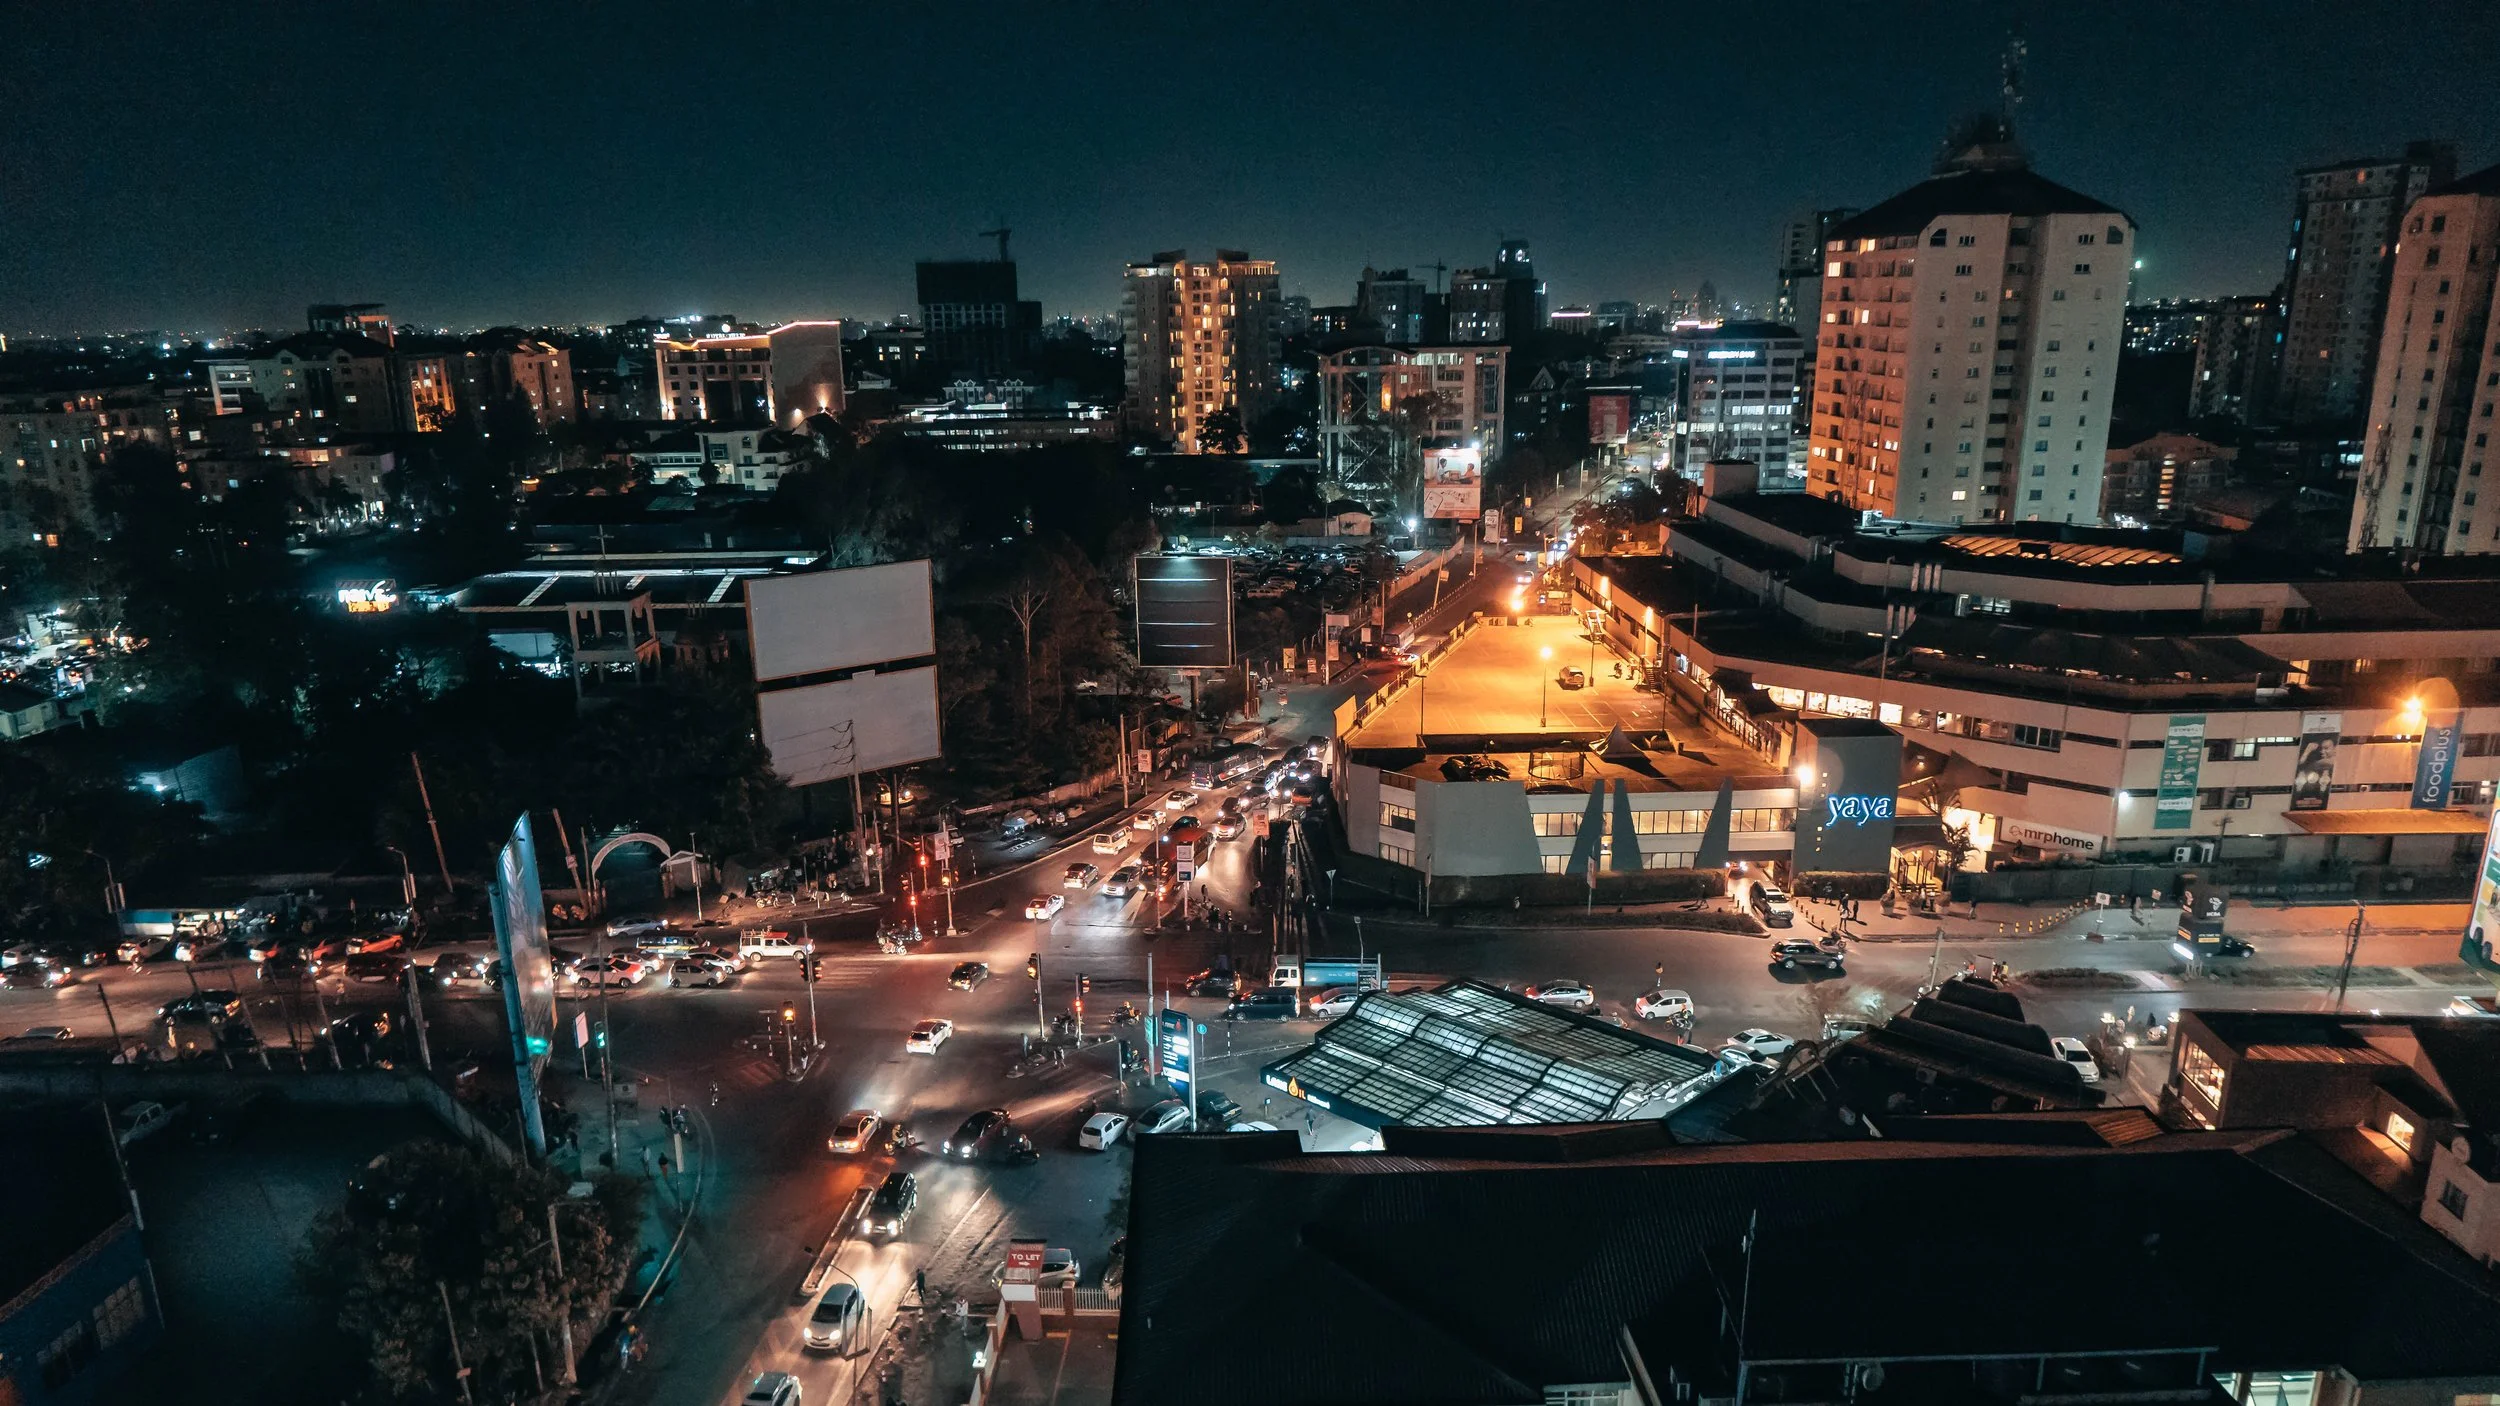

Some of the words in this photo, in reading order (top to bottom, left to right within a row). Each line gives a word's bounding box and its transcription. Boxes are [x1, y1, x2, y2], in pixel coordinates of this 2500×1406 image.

[2422, 729, 2451, 802] foodplus
[1825, 797, 1893, 827] yaya
[1025, 1253, 1040, 1261] LET
